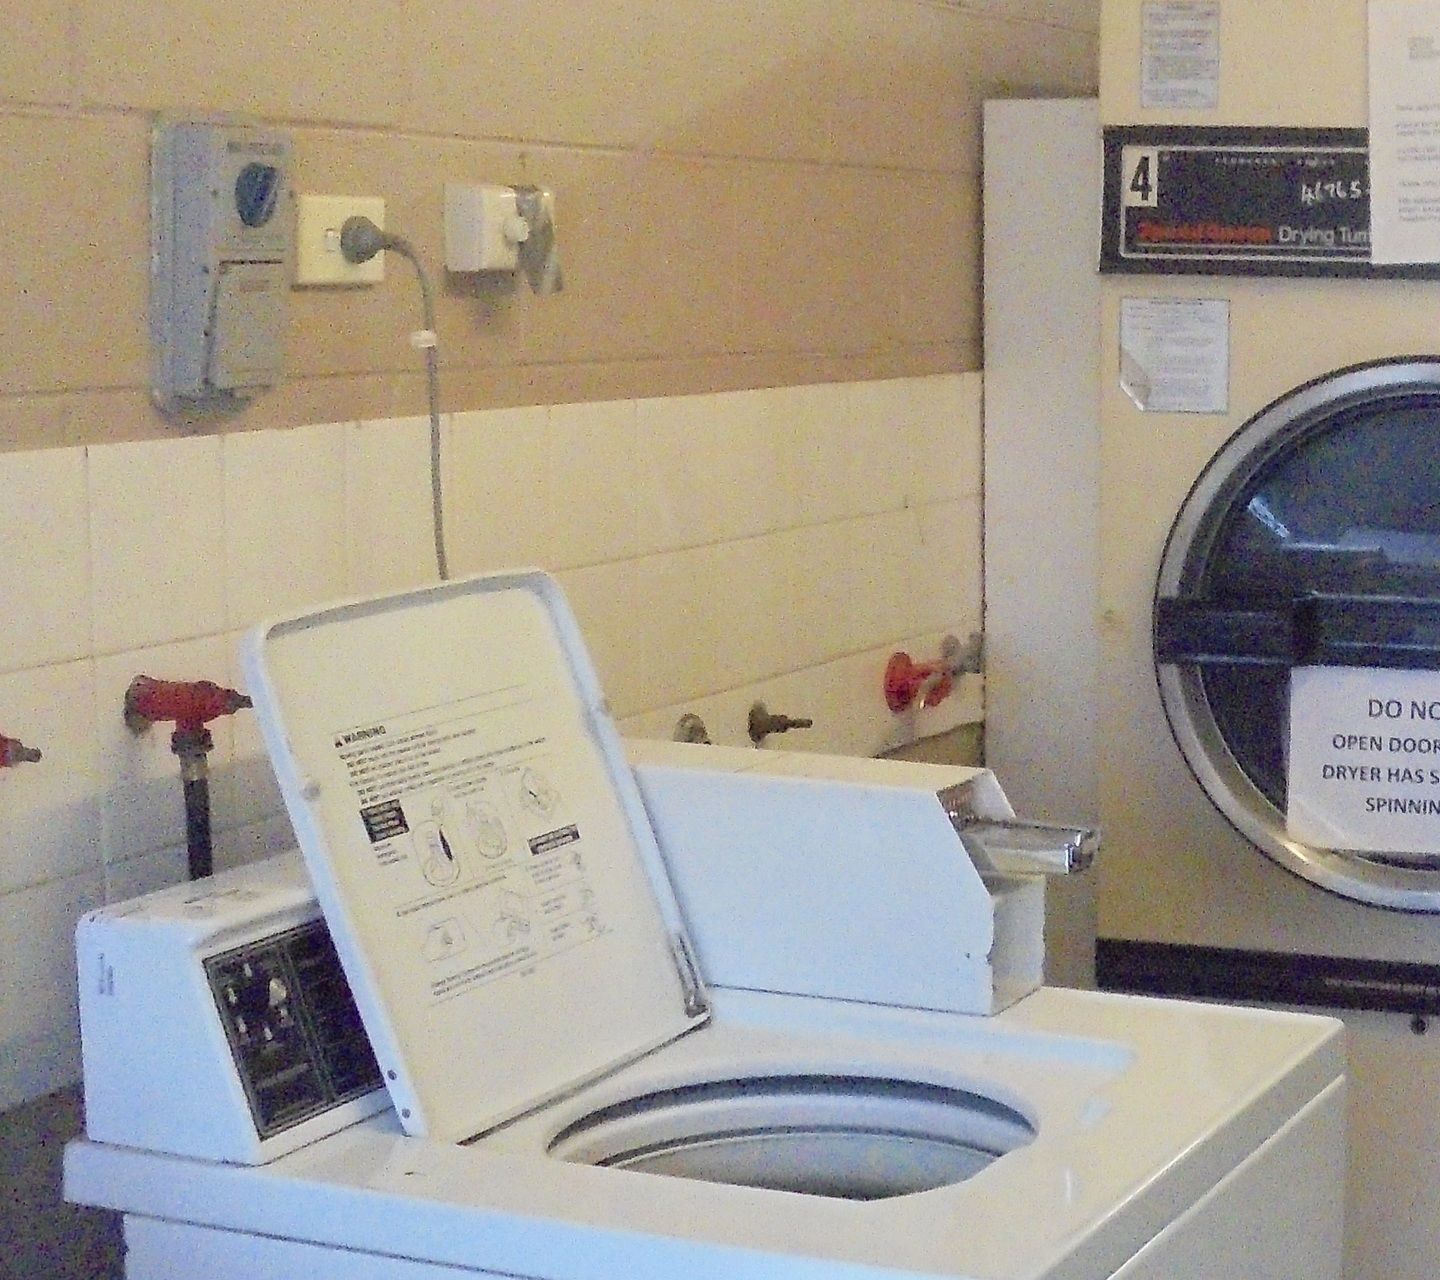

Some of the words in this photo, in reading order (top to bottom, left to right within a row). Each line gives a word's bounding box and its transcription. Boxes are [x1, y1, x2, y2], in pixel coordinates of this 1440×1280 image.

[1130, 156, 1152, 201] 4
[1278, 225, 1334, 247] Drying
[1340, 227, 1370, 243] Tum
[1368, 699, 1403, 720] DO
[342, 725, 387, 744] WARNING
[1332, 734, 1383, 752] OPEN
[1322, 764, 1381, 782] DRYER
[1387, 767, 1424, 784] HAS
